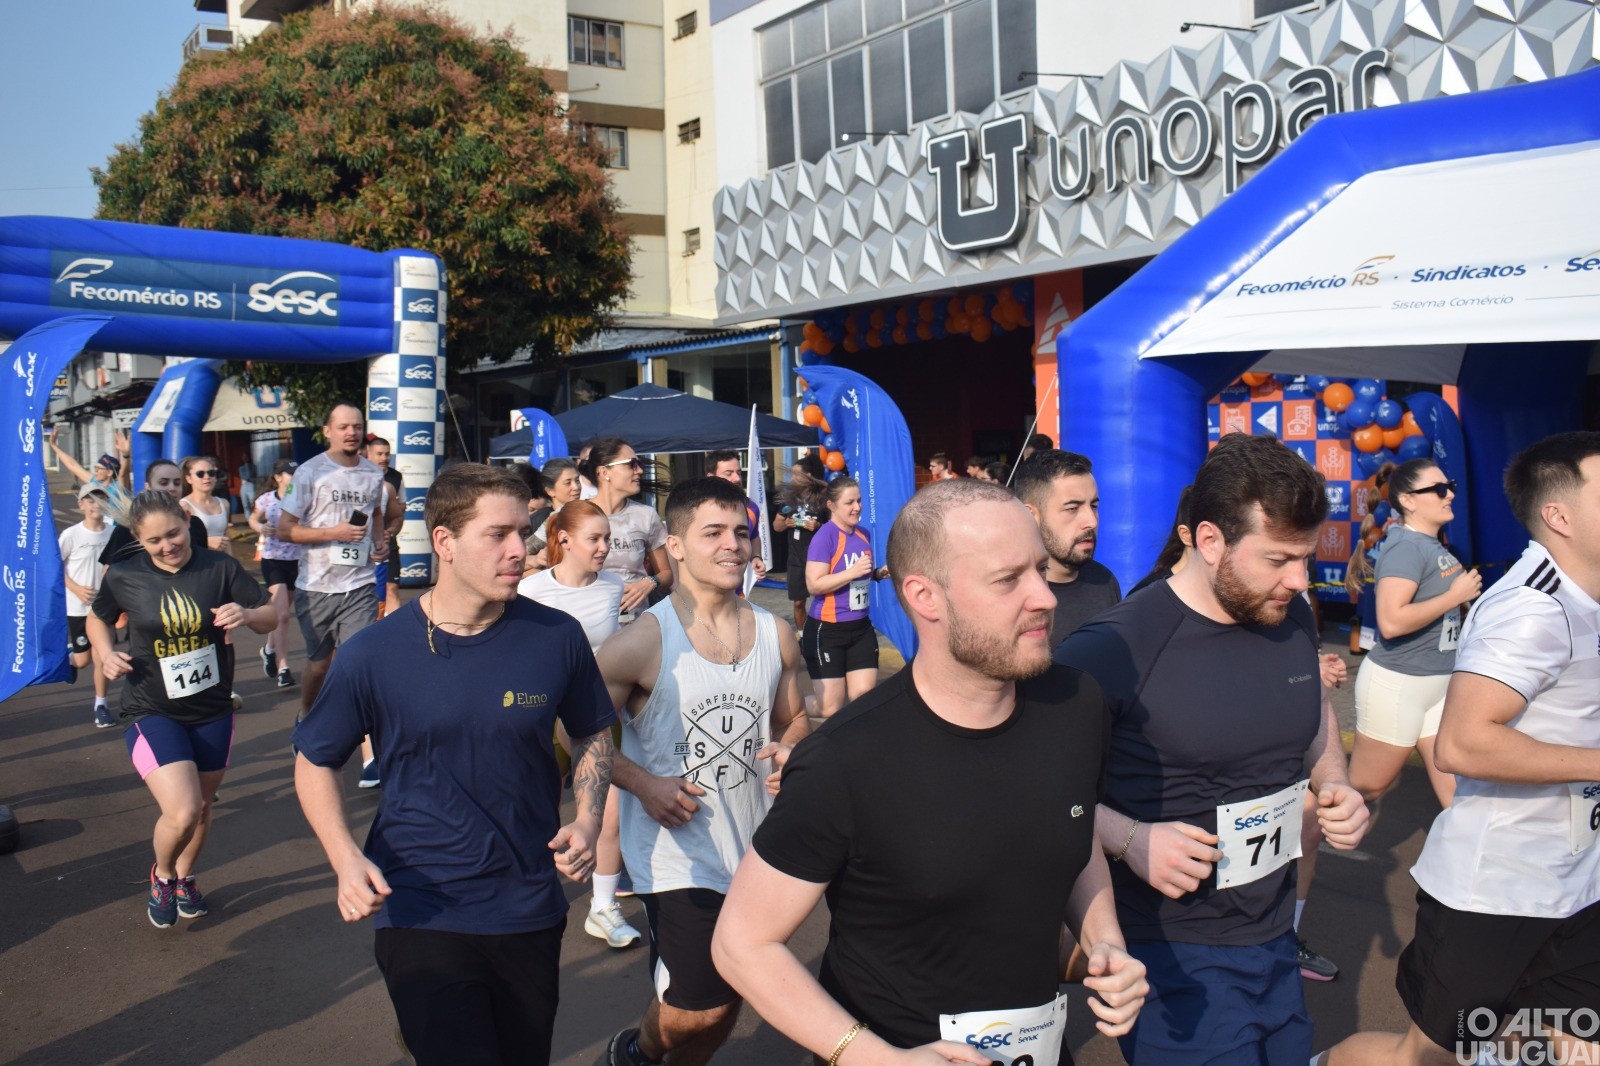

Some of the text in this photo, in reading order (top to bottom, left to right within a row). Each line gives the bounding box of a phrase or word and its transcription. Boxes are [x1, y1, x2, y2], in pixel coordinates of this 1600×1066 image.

[1047, 48, 1388, 201] unopar
[1236, 257, 1600, 297] Fecomércio RS Sindicatos Se
[70, 281, 338, 317] Fecomércio RS Sesc
[1391, 294, 1514, 311] Sistema Comércio
[404, 368, 433, 380] Sesc
[23, 418, 36, 454] Sesc
[402, 434, 432, 446] Sesc
[332, 489, 368, 503] GARRA
[17, 474, 31, 549] Sindicatos
[32, 519, 41, 556] Sistema
[342, 548, 359, 560] 53
[15, 569, 26, 589] RS
[400, 567, 428, 578] Sesc
[12, 592, 26, 673] Fecomércio
[174, 665, 212, 689] 144
[516, 692, 548, 705] Elmo
[691, 693, 762, 716] SURFBOARDS
[1235, 812, 1269, 831] Sesc
[1246, 826, 1281, 867] 71
[966, 1019, 1055, 1050] Sesc Fecomércio
[1018, 1033, 1039, 1044] Senac
